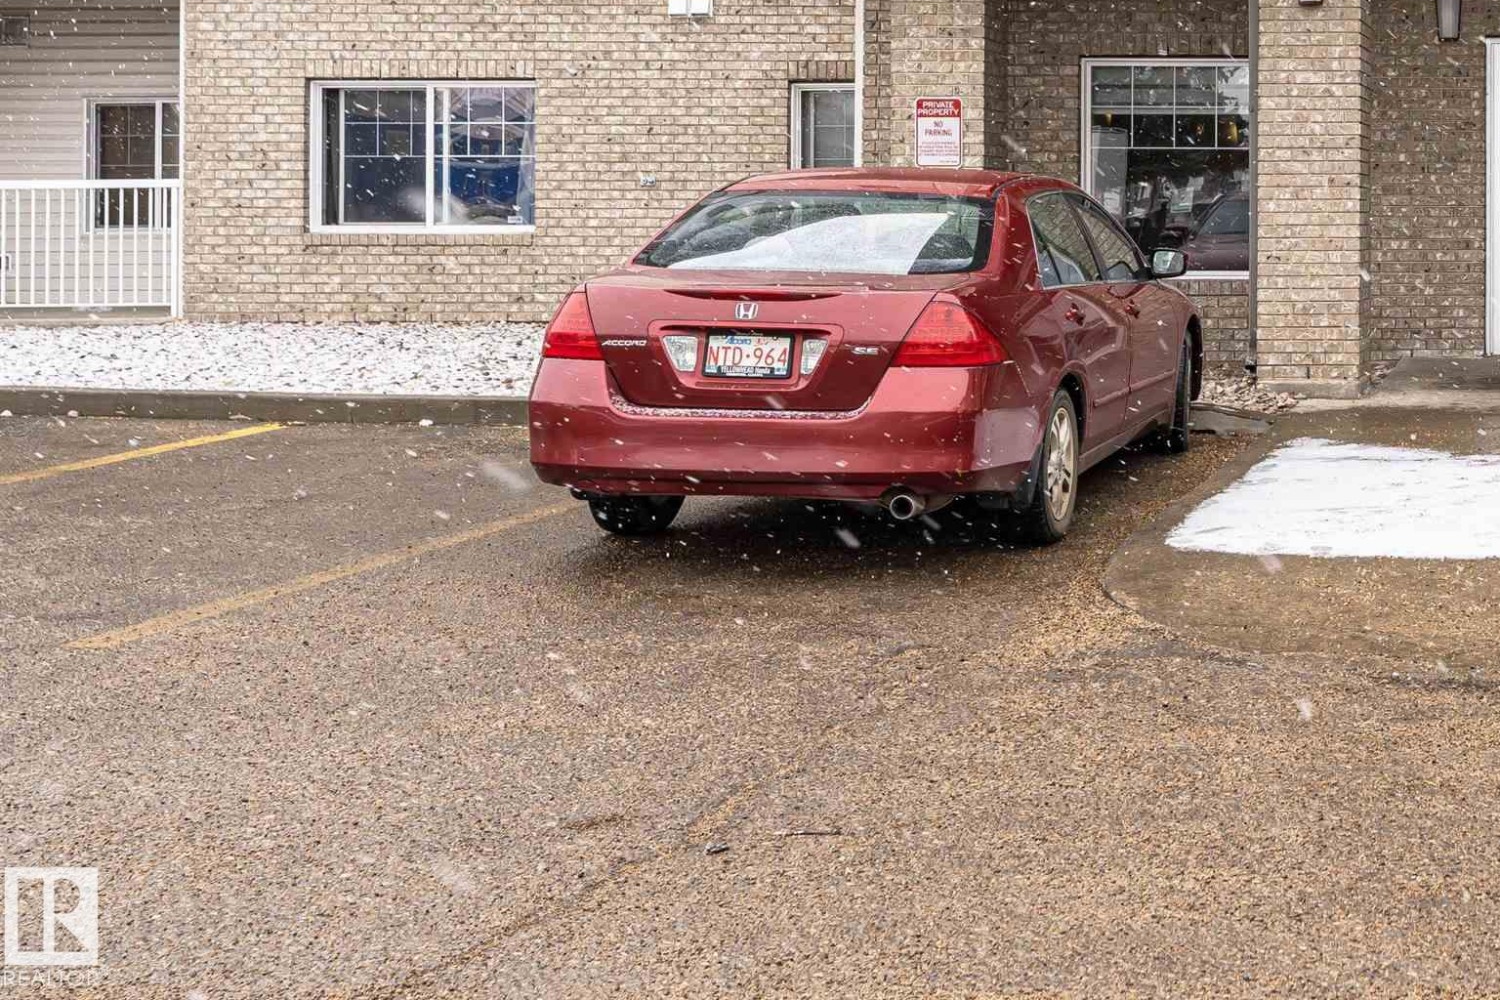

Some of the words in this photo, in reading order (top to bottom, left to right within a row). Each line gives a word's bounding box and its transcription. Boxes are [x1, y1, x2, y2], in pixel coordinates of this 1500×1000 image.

[917, 108, 960, 116] PROPERTY
[933, 120, 944, 128] NO
[924, 128, 953, 137] PARKING
[601, 339, 647, 347] ACCORD
